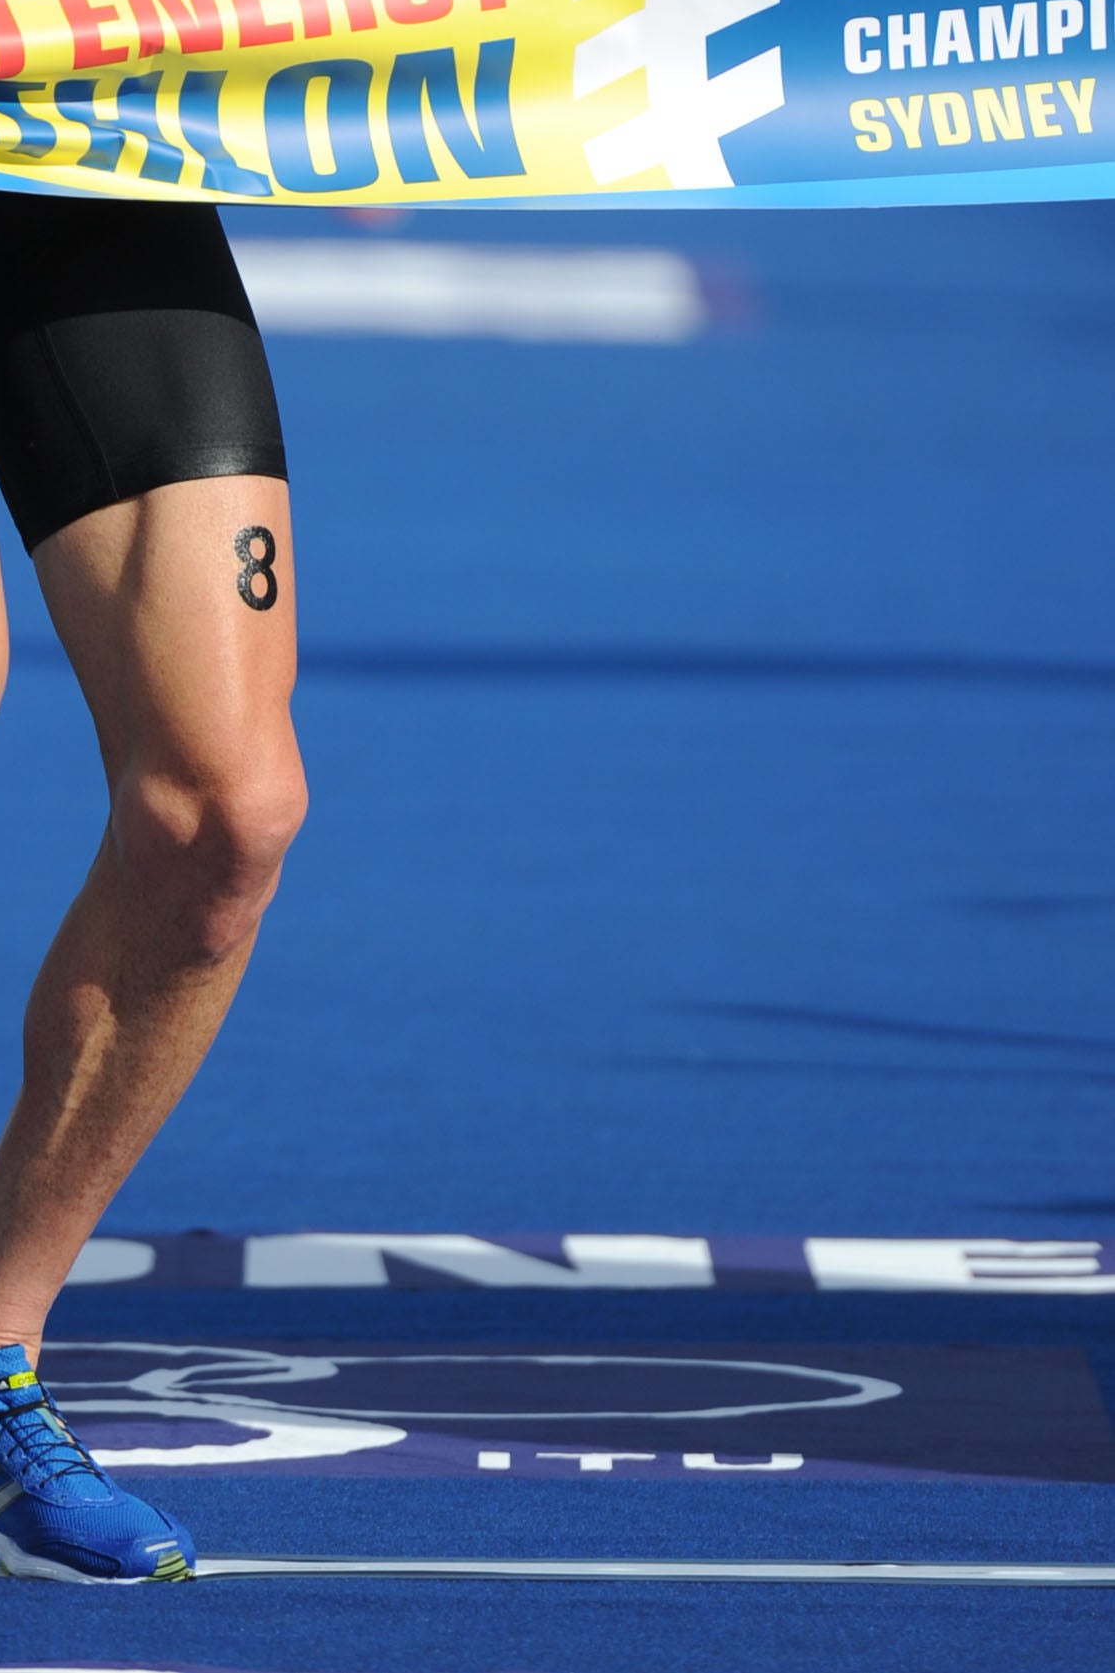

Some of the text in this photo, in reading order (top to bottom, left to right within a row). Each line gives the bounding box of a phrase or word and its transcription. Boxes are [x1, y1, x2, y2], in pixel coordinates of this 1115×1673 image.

[848, 77, 1097, 153] SYDNEY
[233, 525, 278, 611] 8
[478, 1452, 804, 1471] ITU
